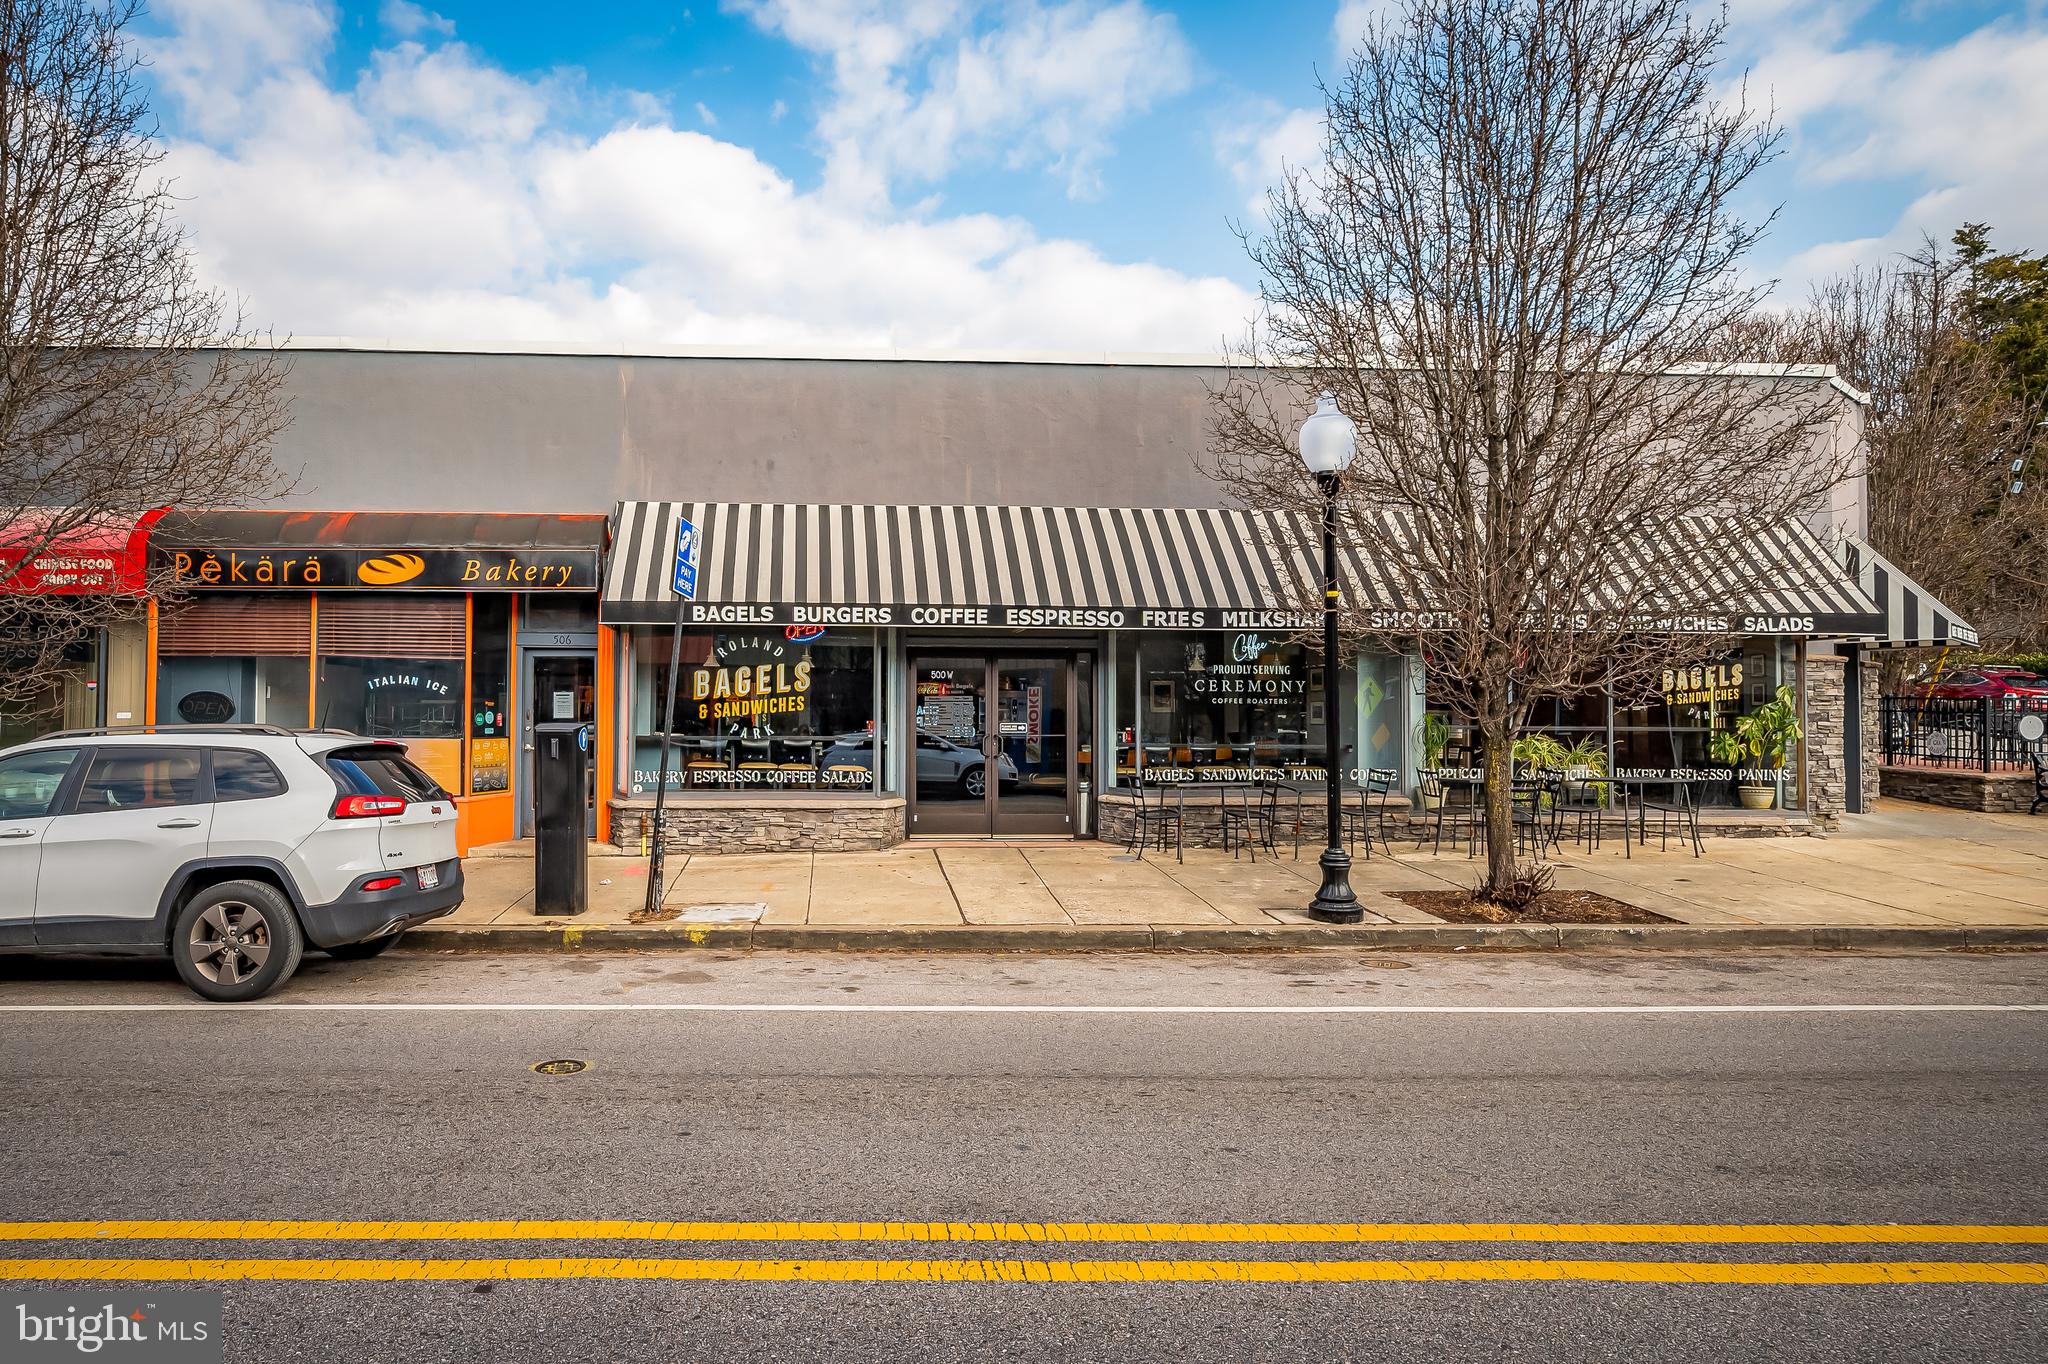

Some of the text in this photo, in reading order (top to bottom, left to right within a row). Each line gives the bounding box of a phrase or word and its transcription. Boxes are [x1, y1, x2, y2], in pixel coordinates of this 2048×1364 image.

[80, 558, 113, 570] FOOD
[461, 558, 573, 587] Bakery
[681, 565, 692, 579] PAY
[677, 576, 693, 593] HERE
[692, 605, 774, 622] BAGELS
[793, 606, 892, 623] BURGERS
[910, 607, 988, 624] COFFEE
[1006, 609, 1125, 627] ESSPRESSO
[1142, 610, 1205, 627] FRIES
[1744, 616, 1814, 632] SALADS
[553, 635, 572, 645] 506
[716, 636, 784, 659] ROLAND
[1232, 633, 1268, 662] Coffee
[1213, 664, 1291, 675] PROUDLY SERVING
[368, 674, 449, 696] ITALIAN ICE
[693, 660, 812, 701] BAGELS
[1662, 663, 1743, 692] BAGELS
[1194, 679, 1306, 693] CEREMONY
[698, 695, 806, 720] & SANDWICHES
[1211, 697, 1244, 705] COFFEE
[1666, 694, 1674, 706] &
[729, 723, 775, 740] PARK
[694, 770, 760, 784] ESPRESSO
[766, 770, 816, 784] COFFEE
[821, 770, 873, 784] SALADS
[1144, 768, 1195, 781] BAGELS
[1202, 768, 1286, 781] SANDWICHES
[1738, 768, 1791, 781] PANINIS
